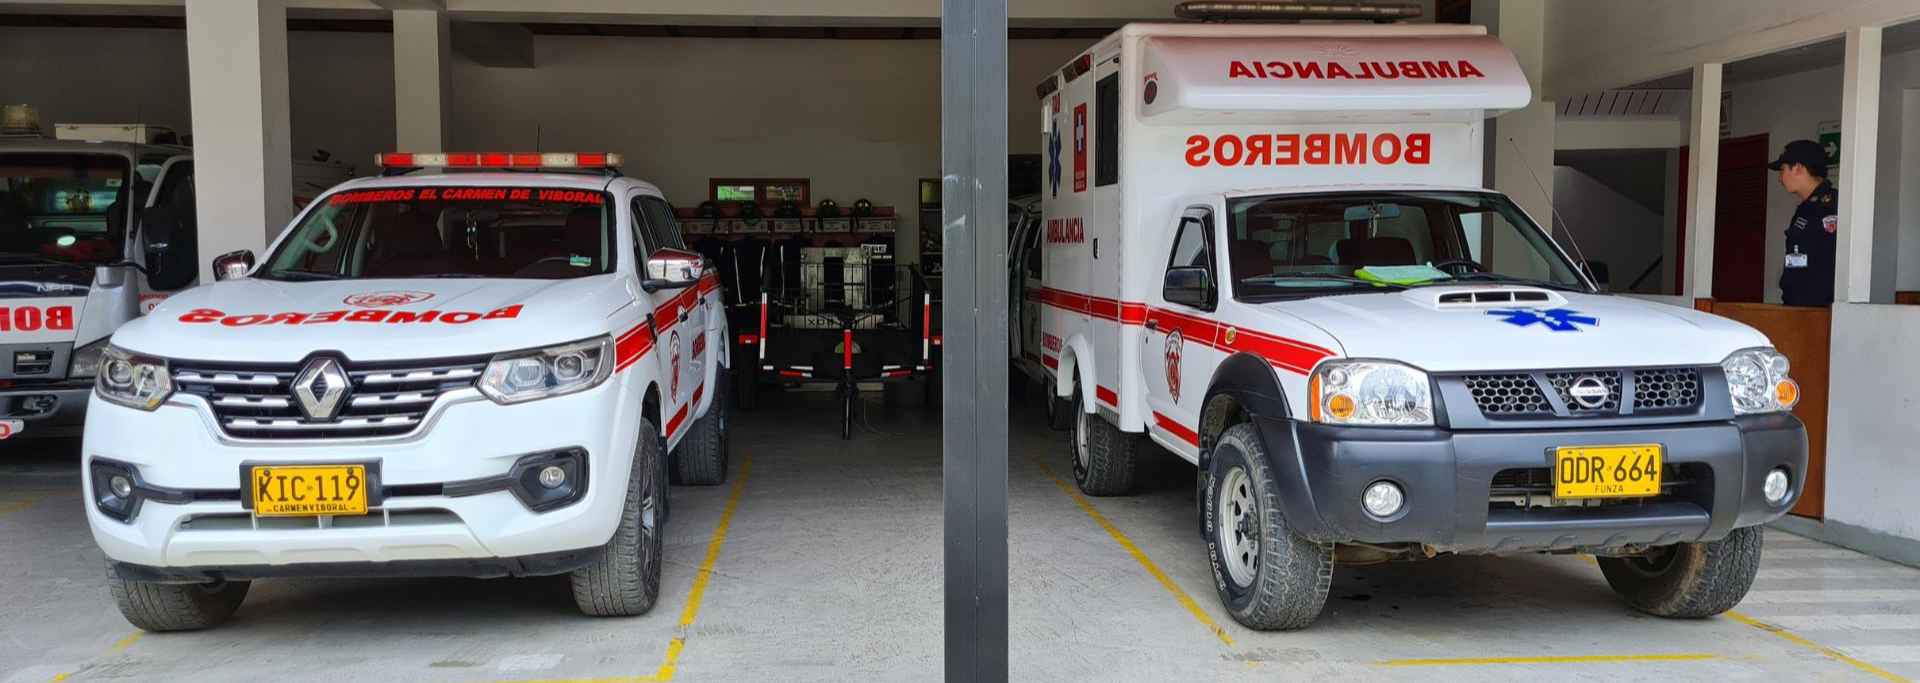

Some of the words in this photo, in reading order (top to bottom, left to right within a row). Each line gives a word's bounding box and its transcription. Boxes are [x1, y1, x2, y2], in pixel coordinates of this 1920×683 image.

[330, 188, 414, 206] BOMBEROS
[418, 187, 438, 200] EL
[441, 187, 506, 201] CARMEN
[509, 188, 531, 201] DE
[538, 188, 605, 205] VIBORAL
[1560, 455, 1604, 484] ODR
[1613, 454, 1658, 482] 664
[258, 475, 305, 502] KIC
[315, 475, 360, 501] 119
[1595, 484, 1624, 494] FUNZA
